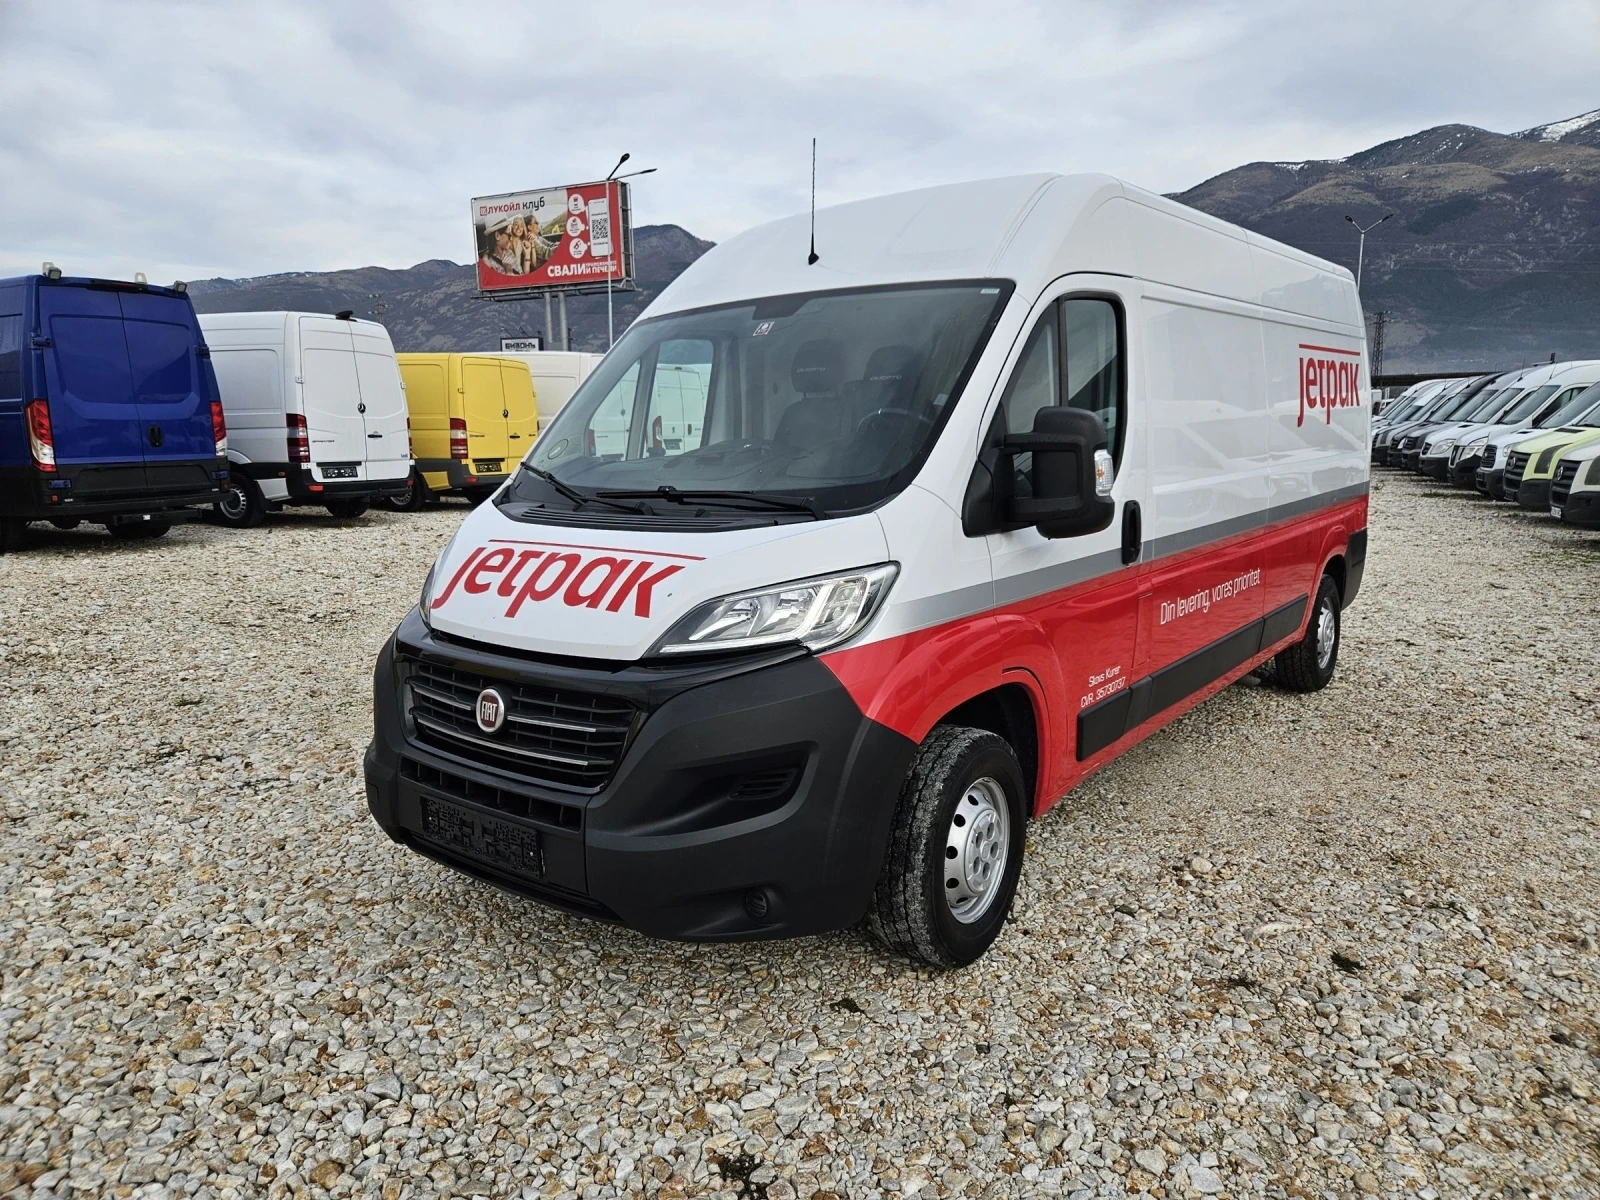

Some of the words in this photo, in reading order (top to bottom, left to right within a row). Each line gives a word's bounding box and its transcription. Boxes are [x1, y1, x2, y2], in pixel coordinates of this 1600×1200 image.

[488, 202, 520, 214] ЛУКОЙЛ
[522, 196, 545, 211] клуб
[547, 263, 586, 277] СВАЛИ
[1297, 357, 1360, 428] jetpak
[431, 546, 686, 618] jetpak
[1160, 601, 1176, 625] Din
[1177, 589, 1210, 618] levering,
[1212, 580, 1233, 602] vores
[1233, 567, 1261, 598] prioritet
[481, 701, 498, 722] FIAT
